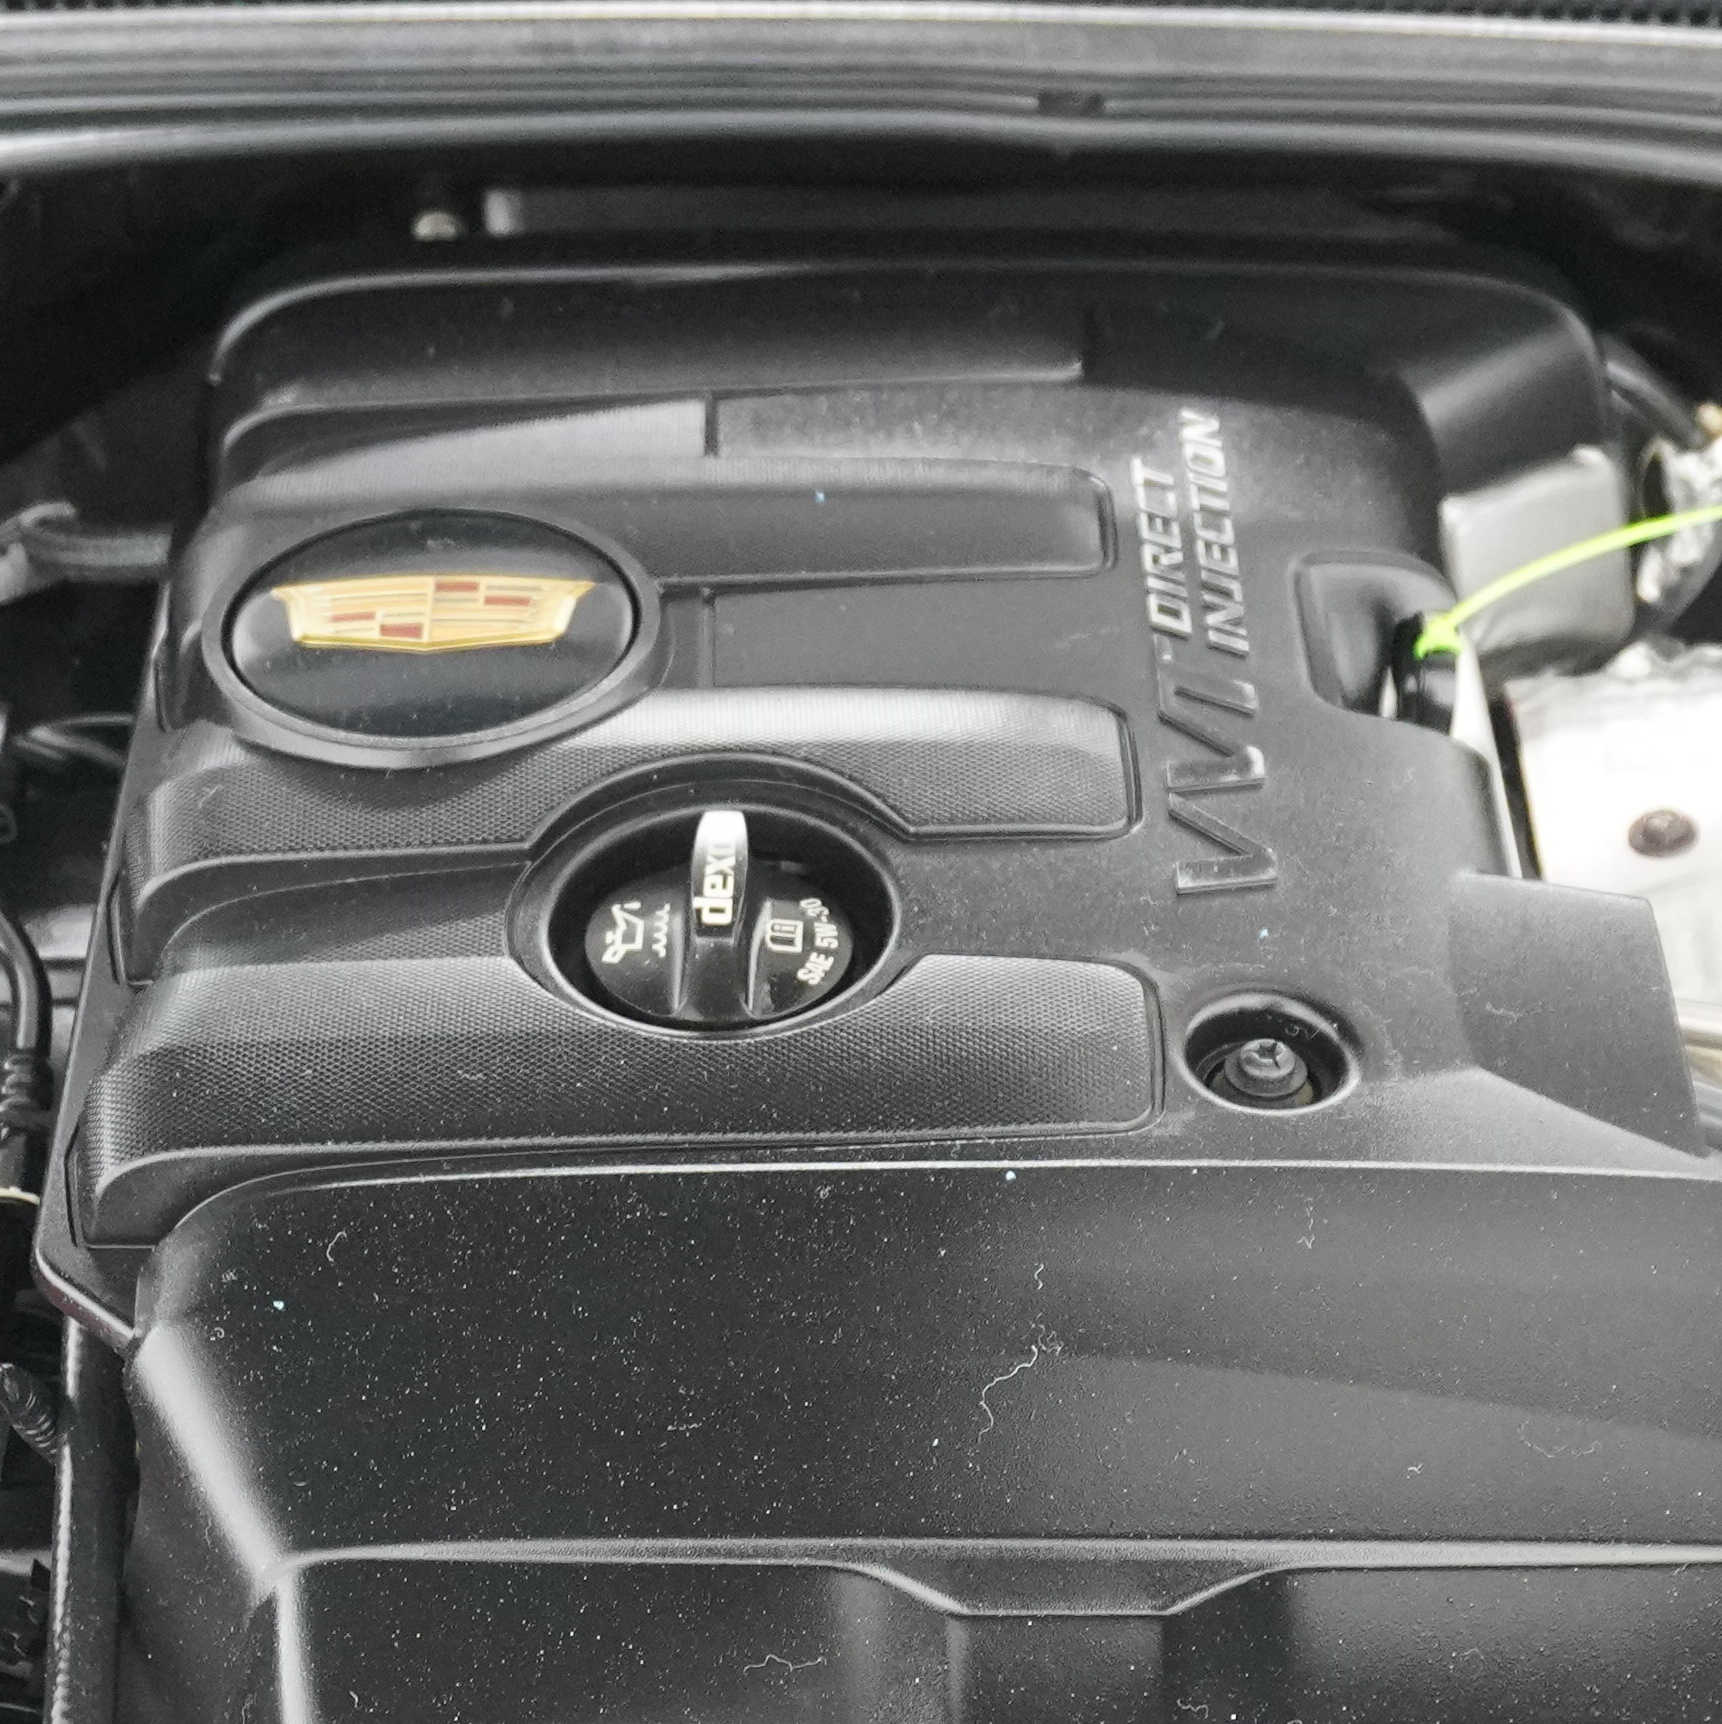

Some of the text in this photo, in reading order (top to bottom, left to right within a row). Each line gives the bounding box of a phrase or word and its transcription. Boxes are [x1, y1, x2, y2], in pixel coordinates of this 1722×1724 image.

[1131, 456, 1192, 638] DIRECT
[1180, 408, 1250, 657] INJECTION
[1155, 632, 1277, 896] VVT
[796, 897, 839, 985] SAE 5W-30
